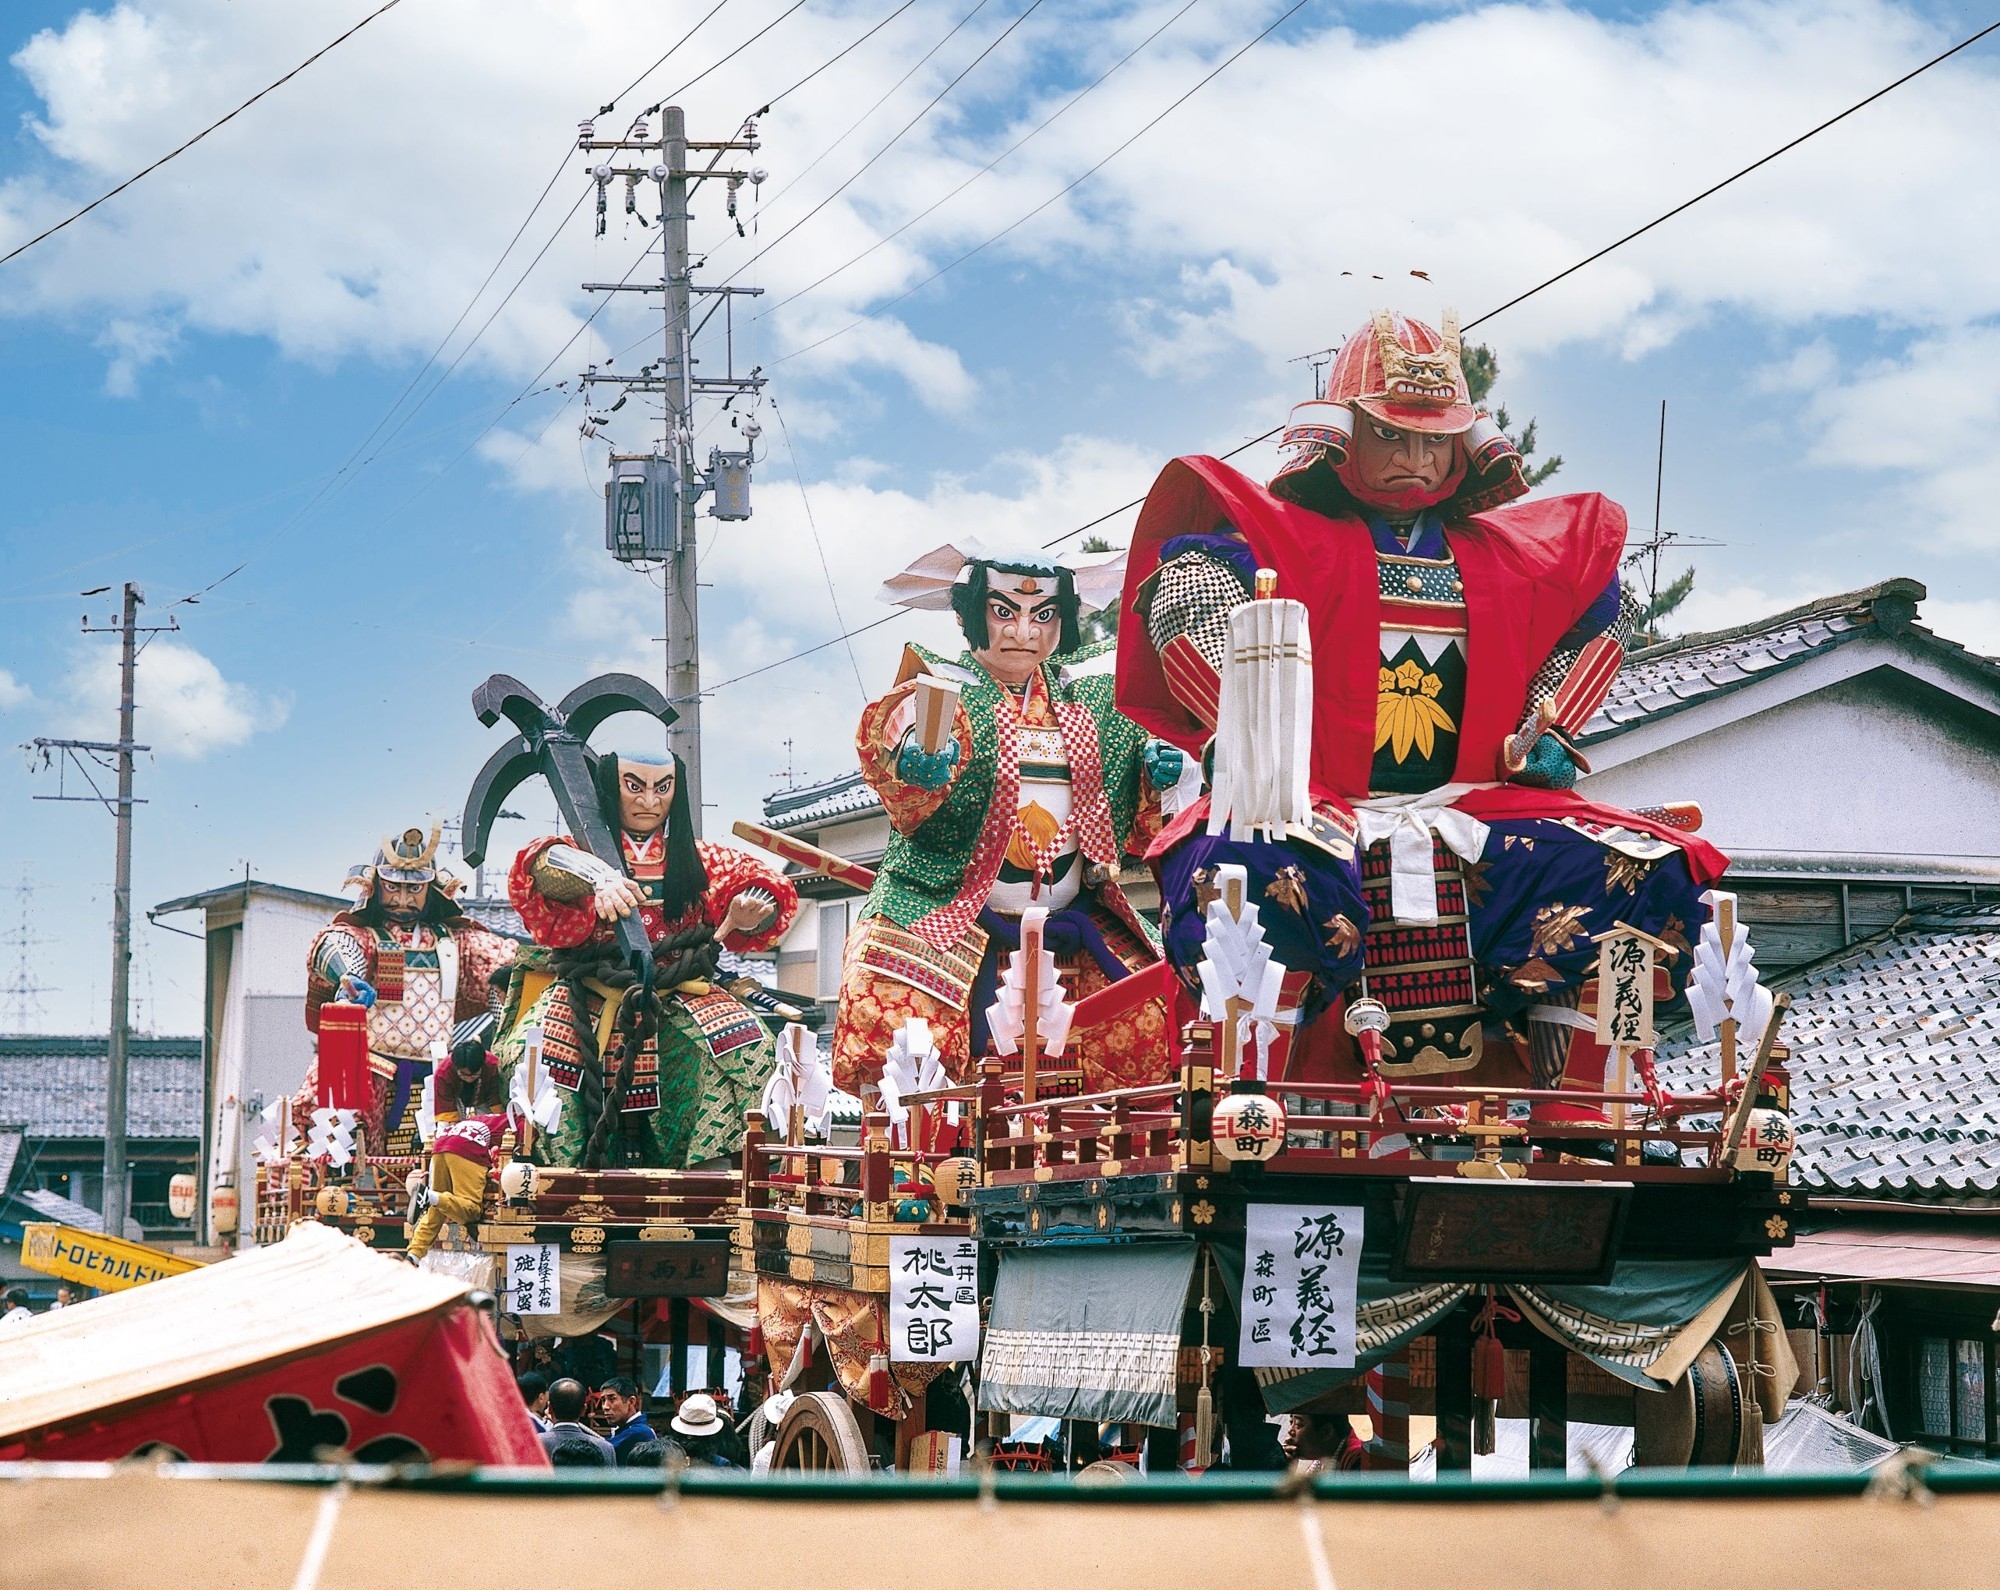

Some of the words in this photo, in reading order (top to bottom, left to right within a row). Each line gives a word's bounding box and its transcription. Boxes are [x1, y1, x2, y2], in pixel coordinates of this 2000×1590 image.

[1236, 1099, 1271, 1157] 森町
[1759, 1113, 1790, 1168] 森町
[956, 1160, 977, 1199] 玉井
[902, 1246, 954, 1357] 桃太郎
